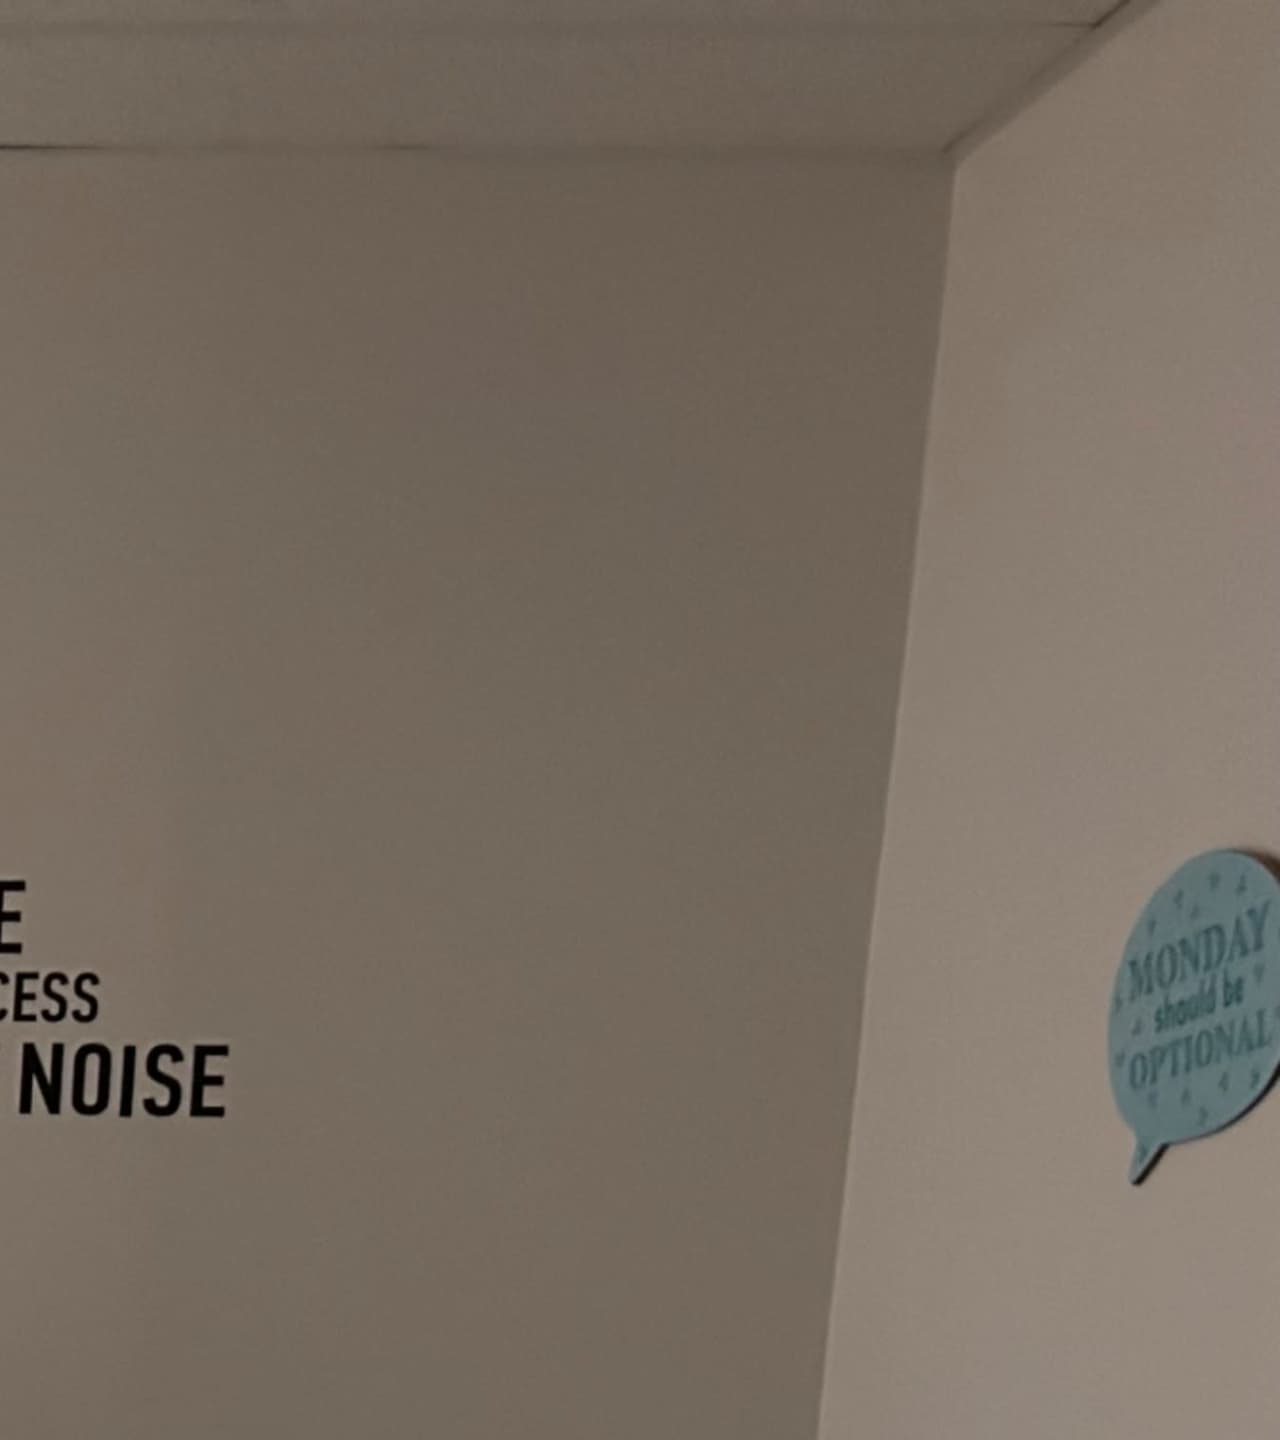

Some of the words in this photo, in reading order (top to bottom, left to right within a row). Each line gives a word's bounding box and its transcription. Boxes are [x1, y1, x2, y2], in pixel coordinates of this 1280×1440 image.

[1127, 901, 1271, 1000] MONDAY
[1153, 970, 1217, 1034] should
[1222, 964, 1245, 1009] be
[18, 1041, 230, 1118] NOISE
[1127, 1007, 1272, 1091] OPTIONAL
